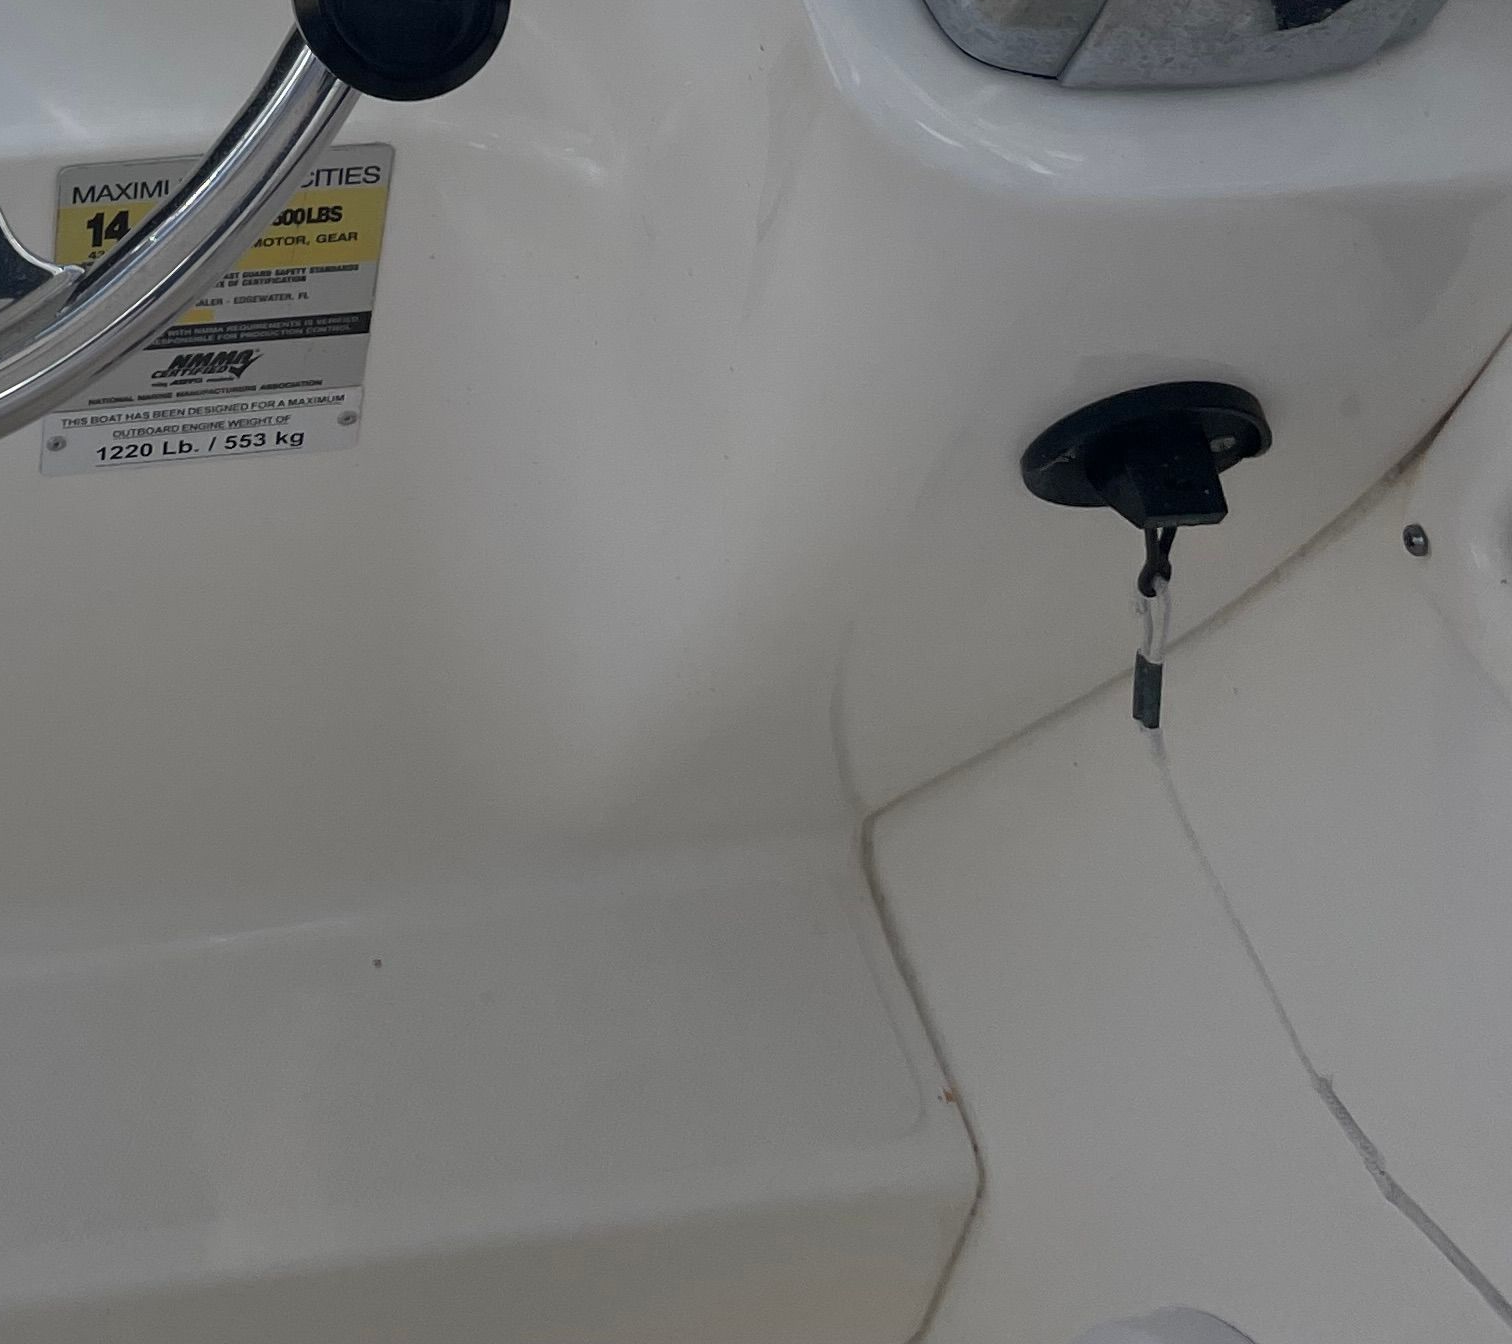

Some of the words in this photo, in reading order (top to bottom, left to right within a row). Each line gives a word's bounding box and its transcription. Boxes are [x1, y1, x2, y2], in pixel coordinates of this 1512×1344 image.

[316, 231, 358, 243] GEAR
[61, 417, 88, 426] THIS
[90, 414, 122, 424] BOAT
[126, 412, 149, 421] HAS
[152, 408, 185, 418] BEEN
[188, 402, 249, 415] DESIGNED
[251, 400, 275, 410] FOR
[288, 394, 345, 406] MAXIMUM
[112, 425, 180, 439] OUTBOARD
[182, 420, 225, 432] ENGINE
[228, 416, 273, 429] WEIGHT
[276, 415, 292, 424] OF
[96, 443, 153, 461] 1220
[162, 440, 200, 455] Lb.
[224, 432, 266, 450] 553
[275, 431, 305, 447] kg
